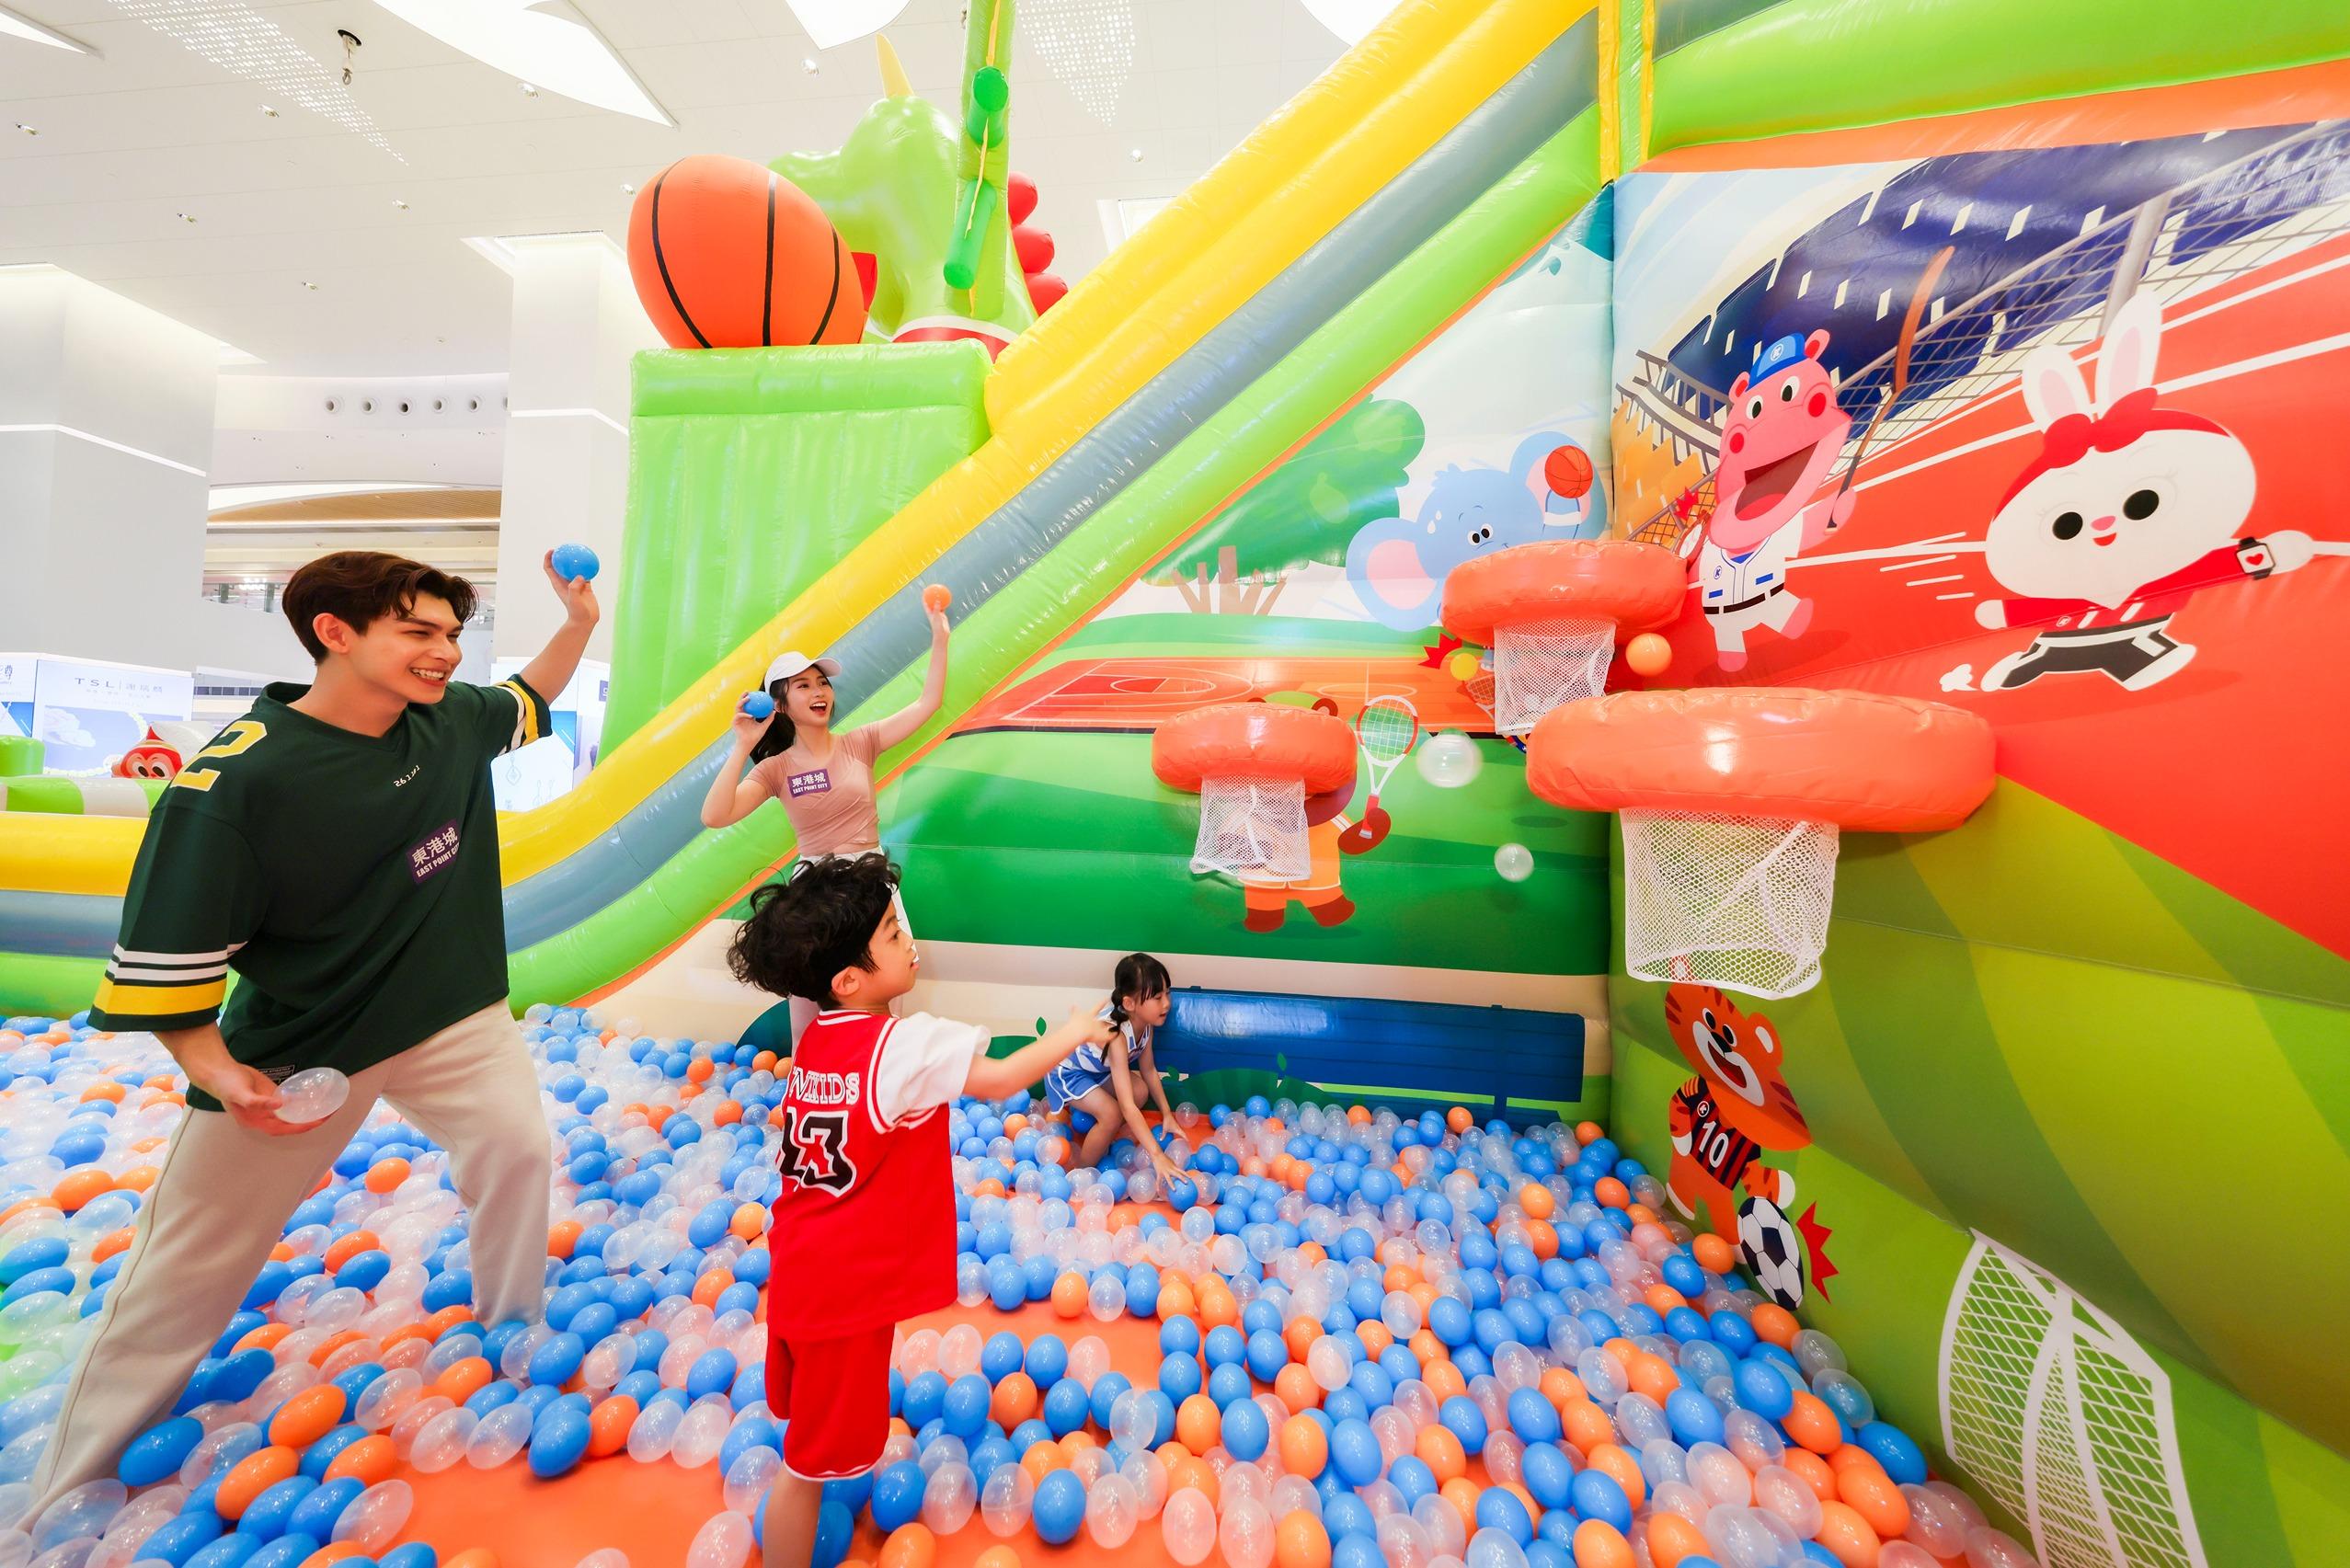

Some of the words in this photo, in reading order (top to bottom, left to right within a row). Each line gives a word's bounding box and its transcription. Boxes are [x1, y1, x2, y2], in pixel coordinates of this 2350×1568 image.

[75, 677, 115, 689] TSL
[792, 773, 826, 787] 東港城
[411, 827, 458, 868] 東港城
[416, 862, 433, 878] EAST
[432, 850, 452, 867] POINT
[779, 1105, 858, 1198] 13
[1698, 1120, 1729, 1168] 10
